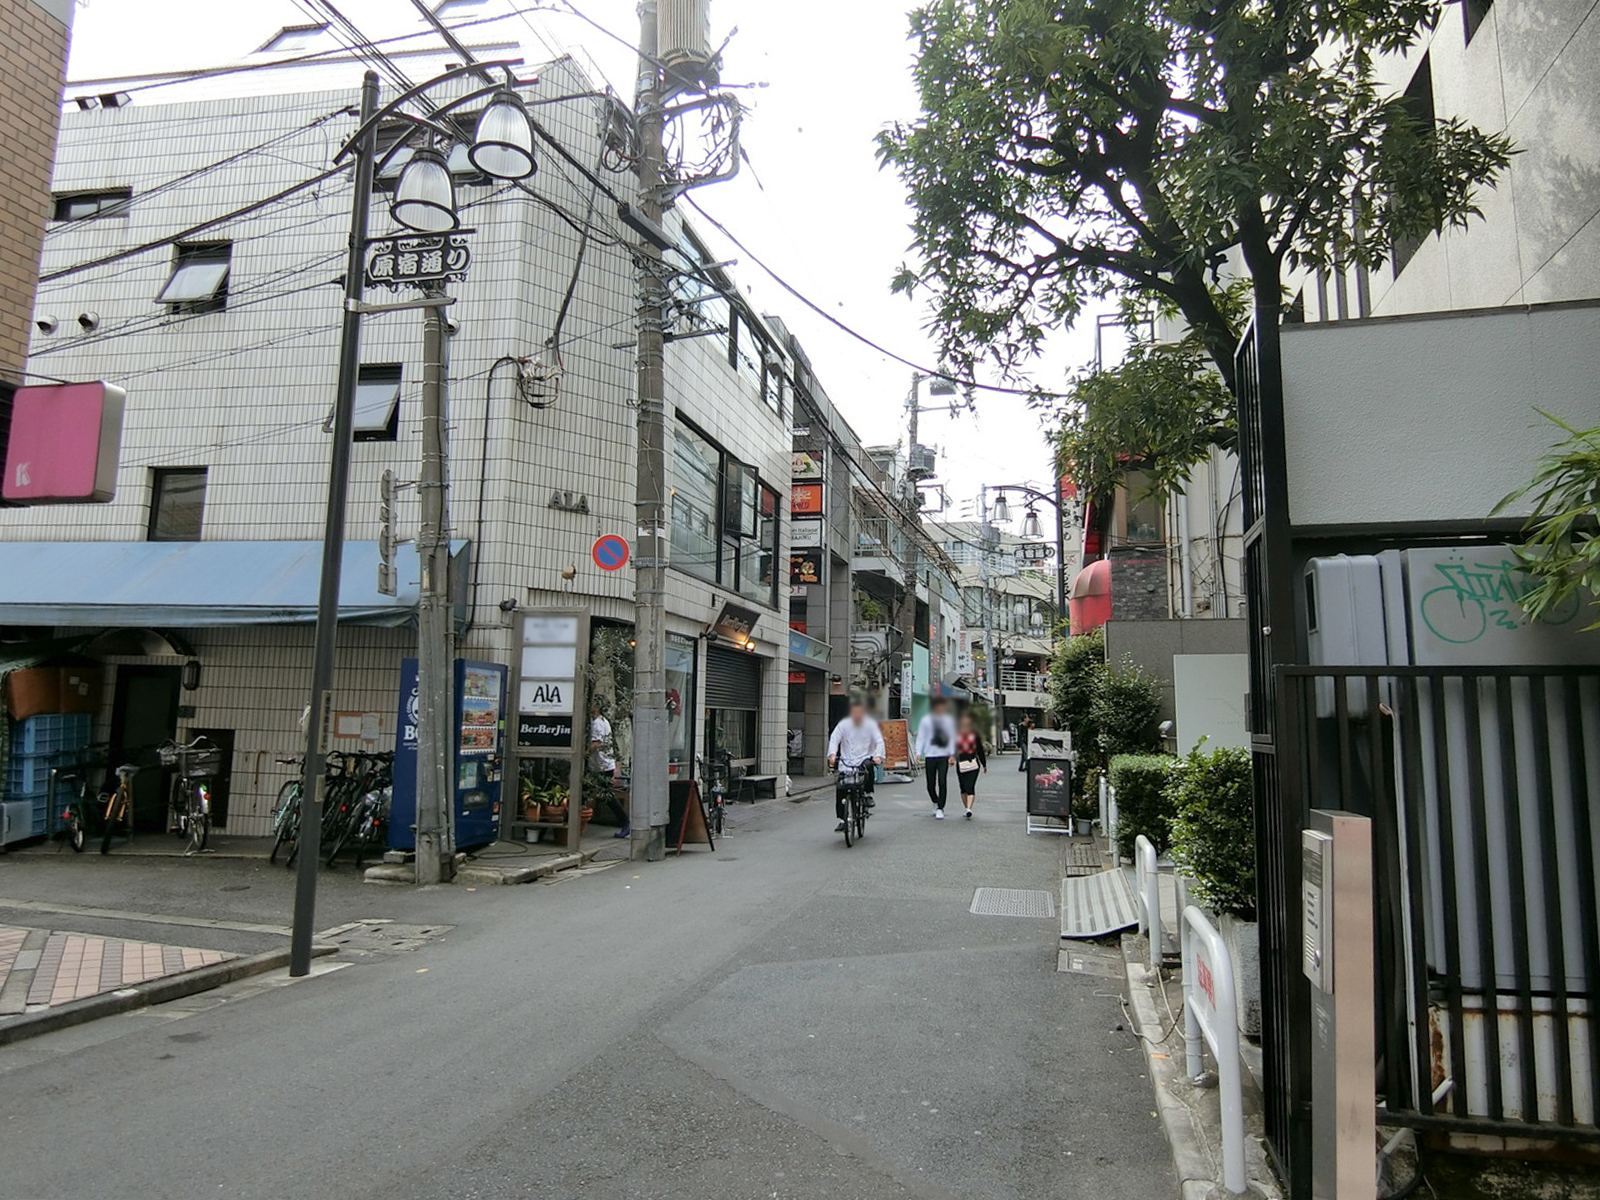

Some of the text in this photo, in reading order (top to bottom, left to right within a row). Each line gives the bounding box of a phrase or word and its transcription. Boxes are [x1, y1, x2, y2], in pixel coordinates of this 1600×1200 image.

[373, 249, 466, 276] 原宿通り
[532, 683, 562, 703] ALA
[520, 723, 571, 737] BerBerJin
